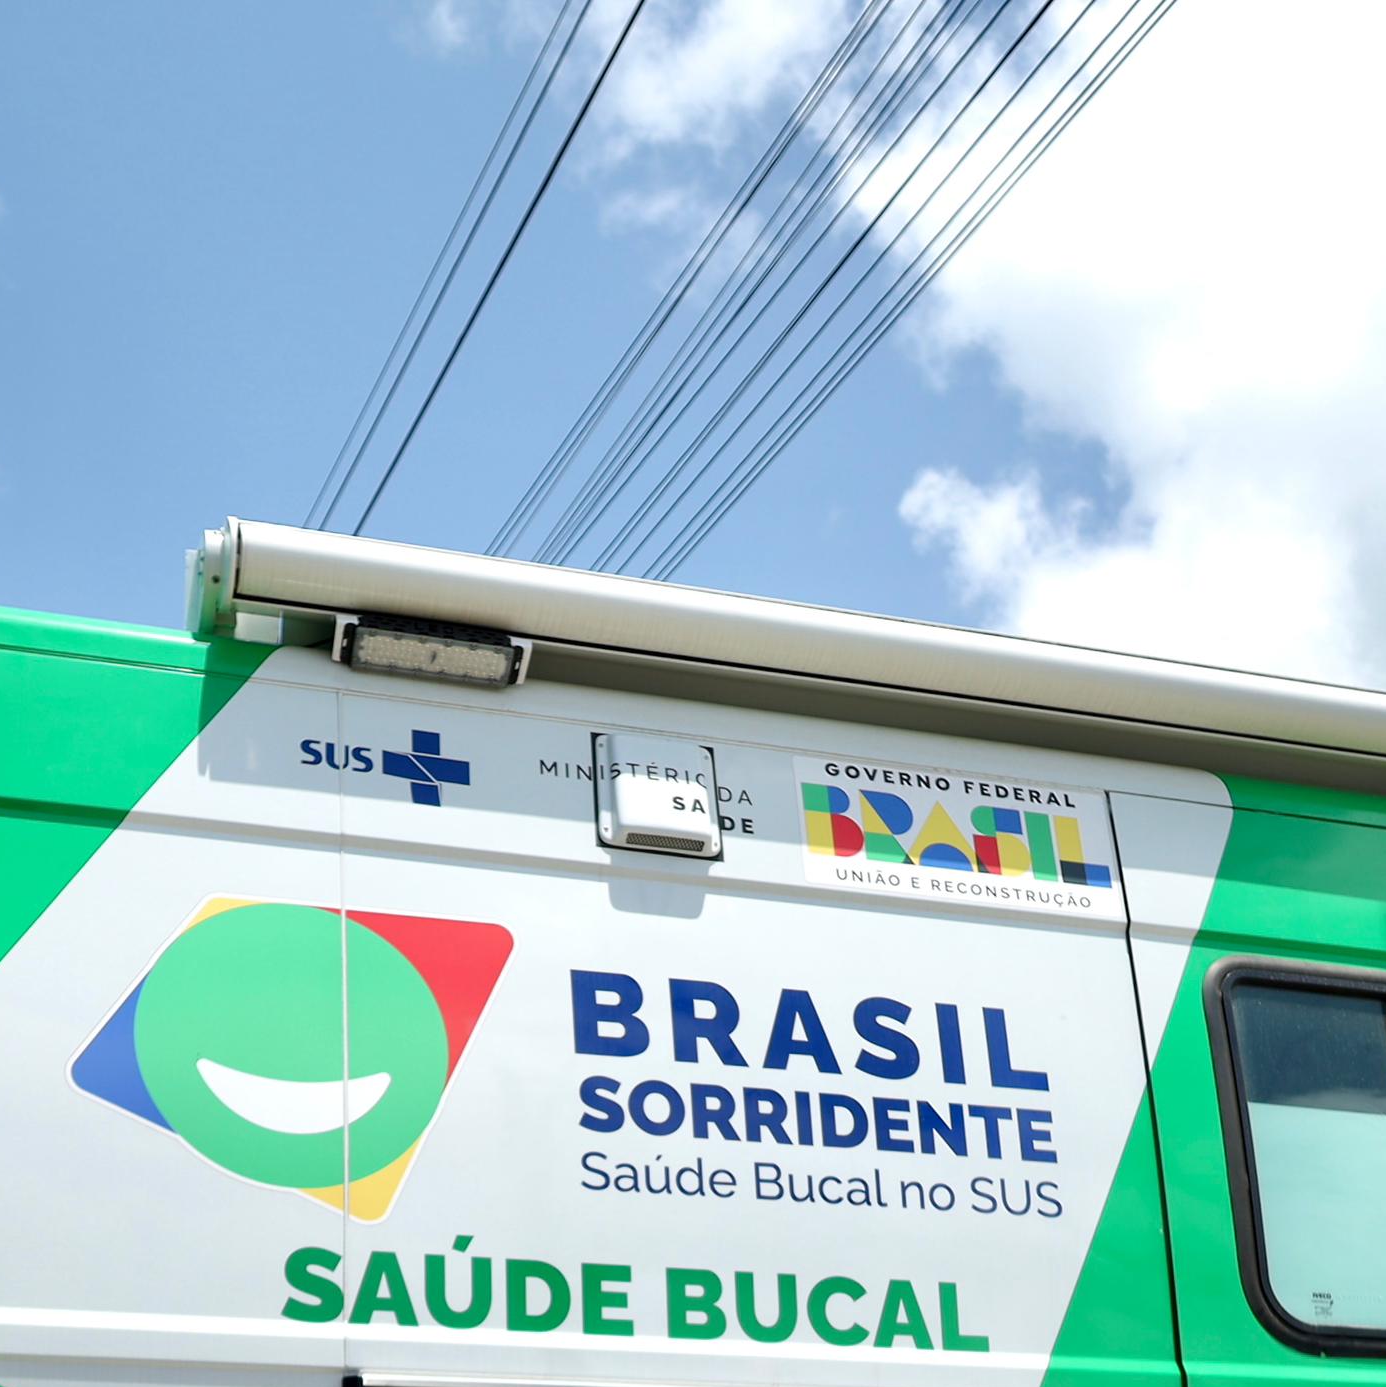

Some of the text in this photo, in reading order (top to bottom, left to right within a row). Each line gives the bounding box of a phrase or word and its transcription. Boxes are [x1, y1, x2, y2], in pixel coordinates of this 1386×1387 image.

[300, 739, 373, 773] SUS
[825, 763, 1076, 808] GOVERNO FEDERAL
[717, 786, 753, 806] DA
[800, 782, 1113, 888] BRASIL
[835, 868, 1091, 908] UNIÃO E RECONSTRUÇÃO
[570, 969, 1050, 1092] BRASIL
[578, 1075, 1058, 1164] SORRIDENTE
[580, 1151, 1064, 1218] Saúde Bucal no SUS
[281, 1235, 990, 1353] SAÚDE BUCAL
